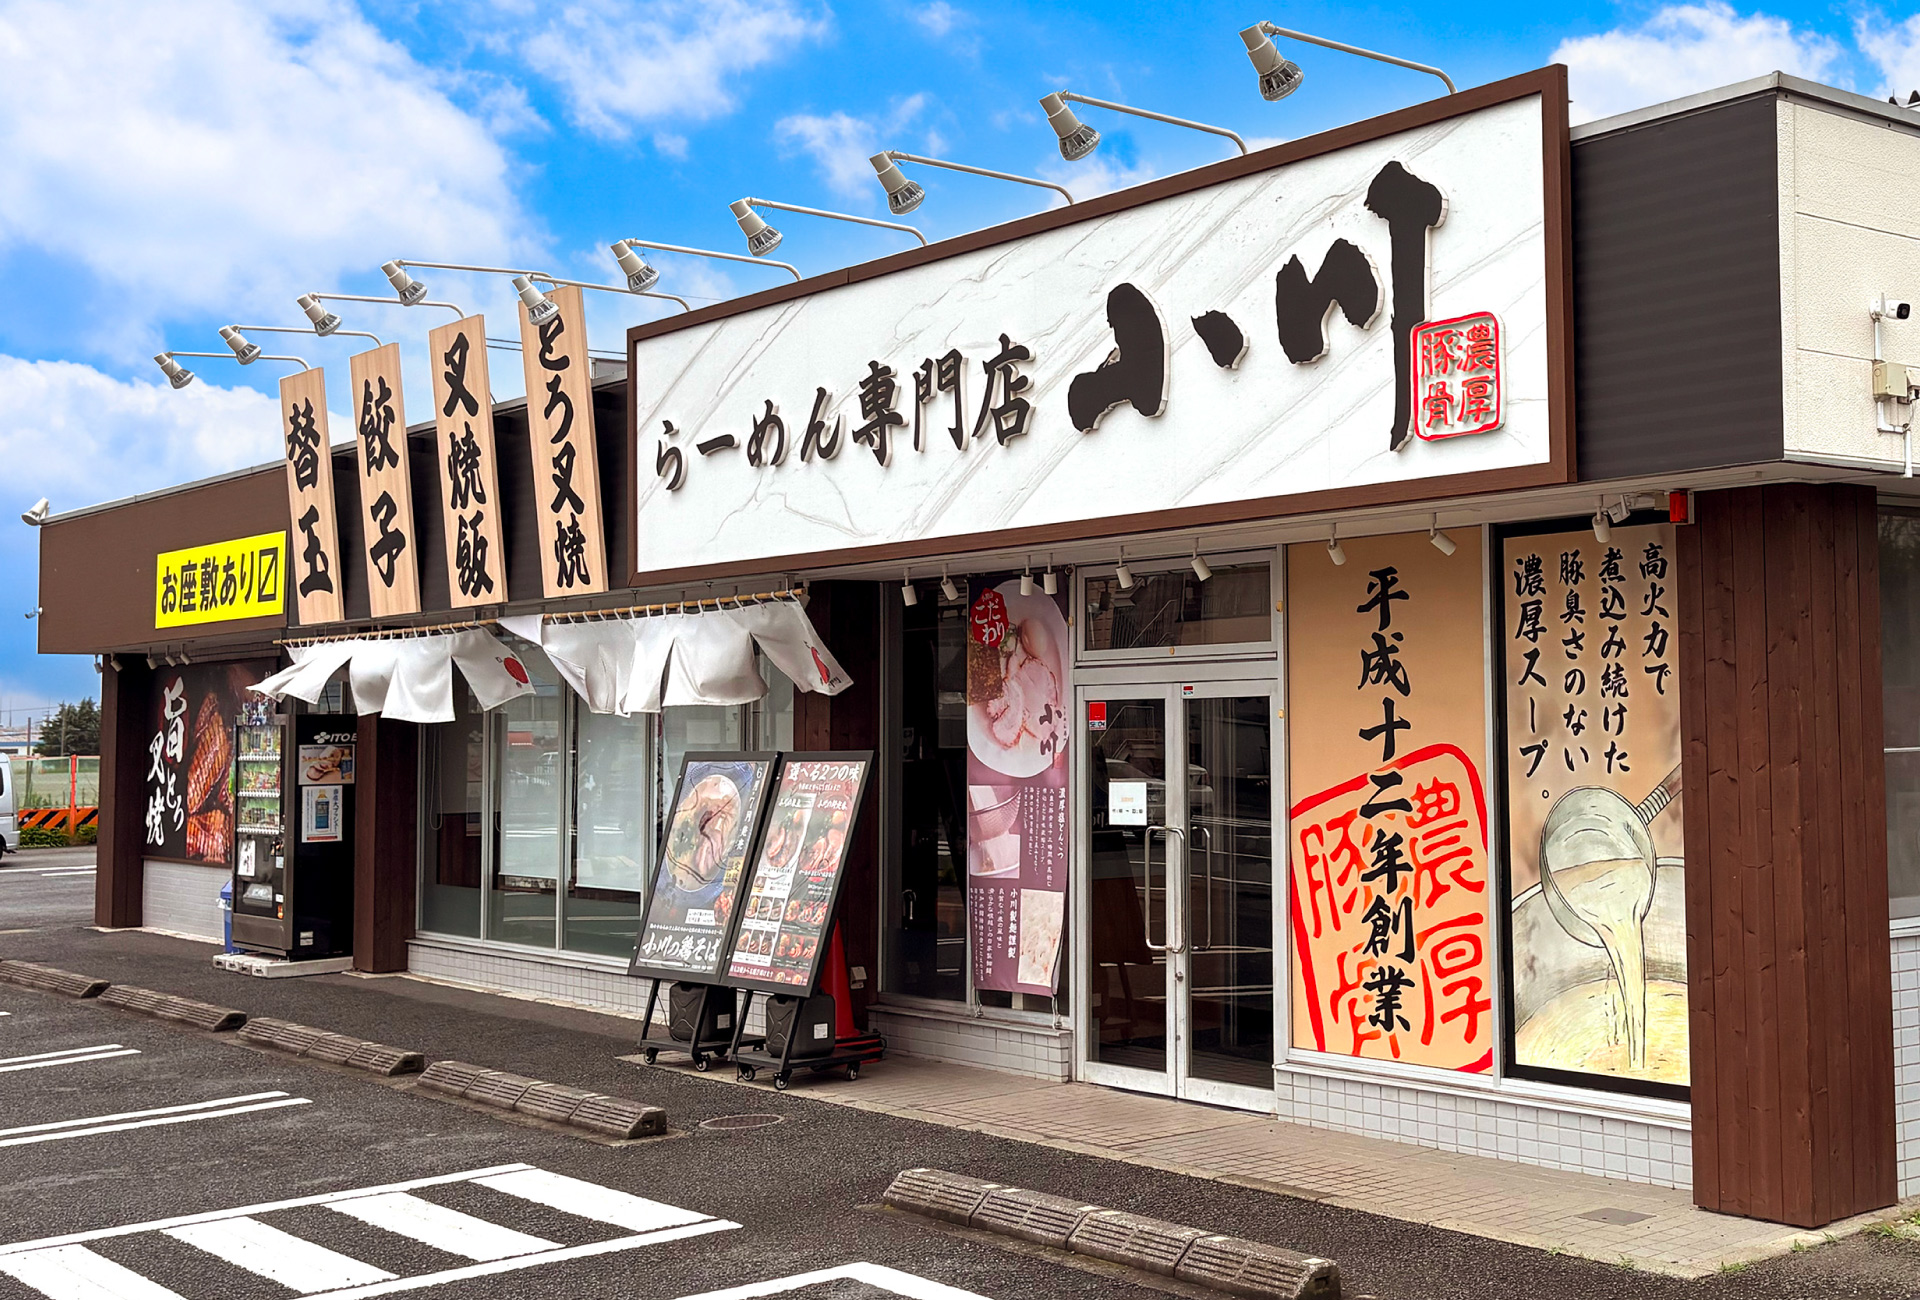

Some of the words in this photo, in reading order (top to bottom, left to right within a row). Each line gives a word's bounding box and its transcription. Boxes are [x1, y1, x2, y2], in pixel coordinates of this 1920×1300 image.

[656, 333, 1034, 492] らーめん専門店
[1069, 160, 1448, 452] 小川
[1420, 328, 1455, 428] 豚骨
[1456, 321, 1494, 423] 濃厚
[287, 396, 334, 599] 替玉
[359, 375, 407, 588] 餃子
[442, 331, 495, 599] 叉焼飯
[1512, 552, 1553, 801] 濃厚スープ。
[1557, 550, 1591, 774] 豚臭さのない
[1597, 545, 1632, 776] 煮込み続けた
[1638, 542, 1671, 696] 高火力で
[330, 733, 350, 743] ITO
[1039, 703, 1062, 768] 小川
[1356, 565, 1416, 1034] 平成十二年創業
[1407, 774, 1492, 1047] 濃厚
